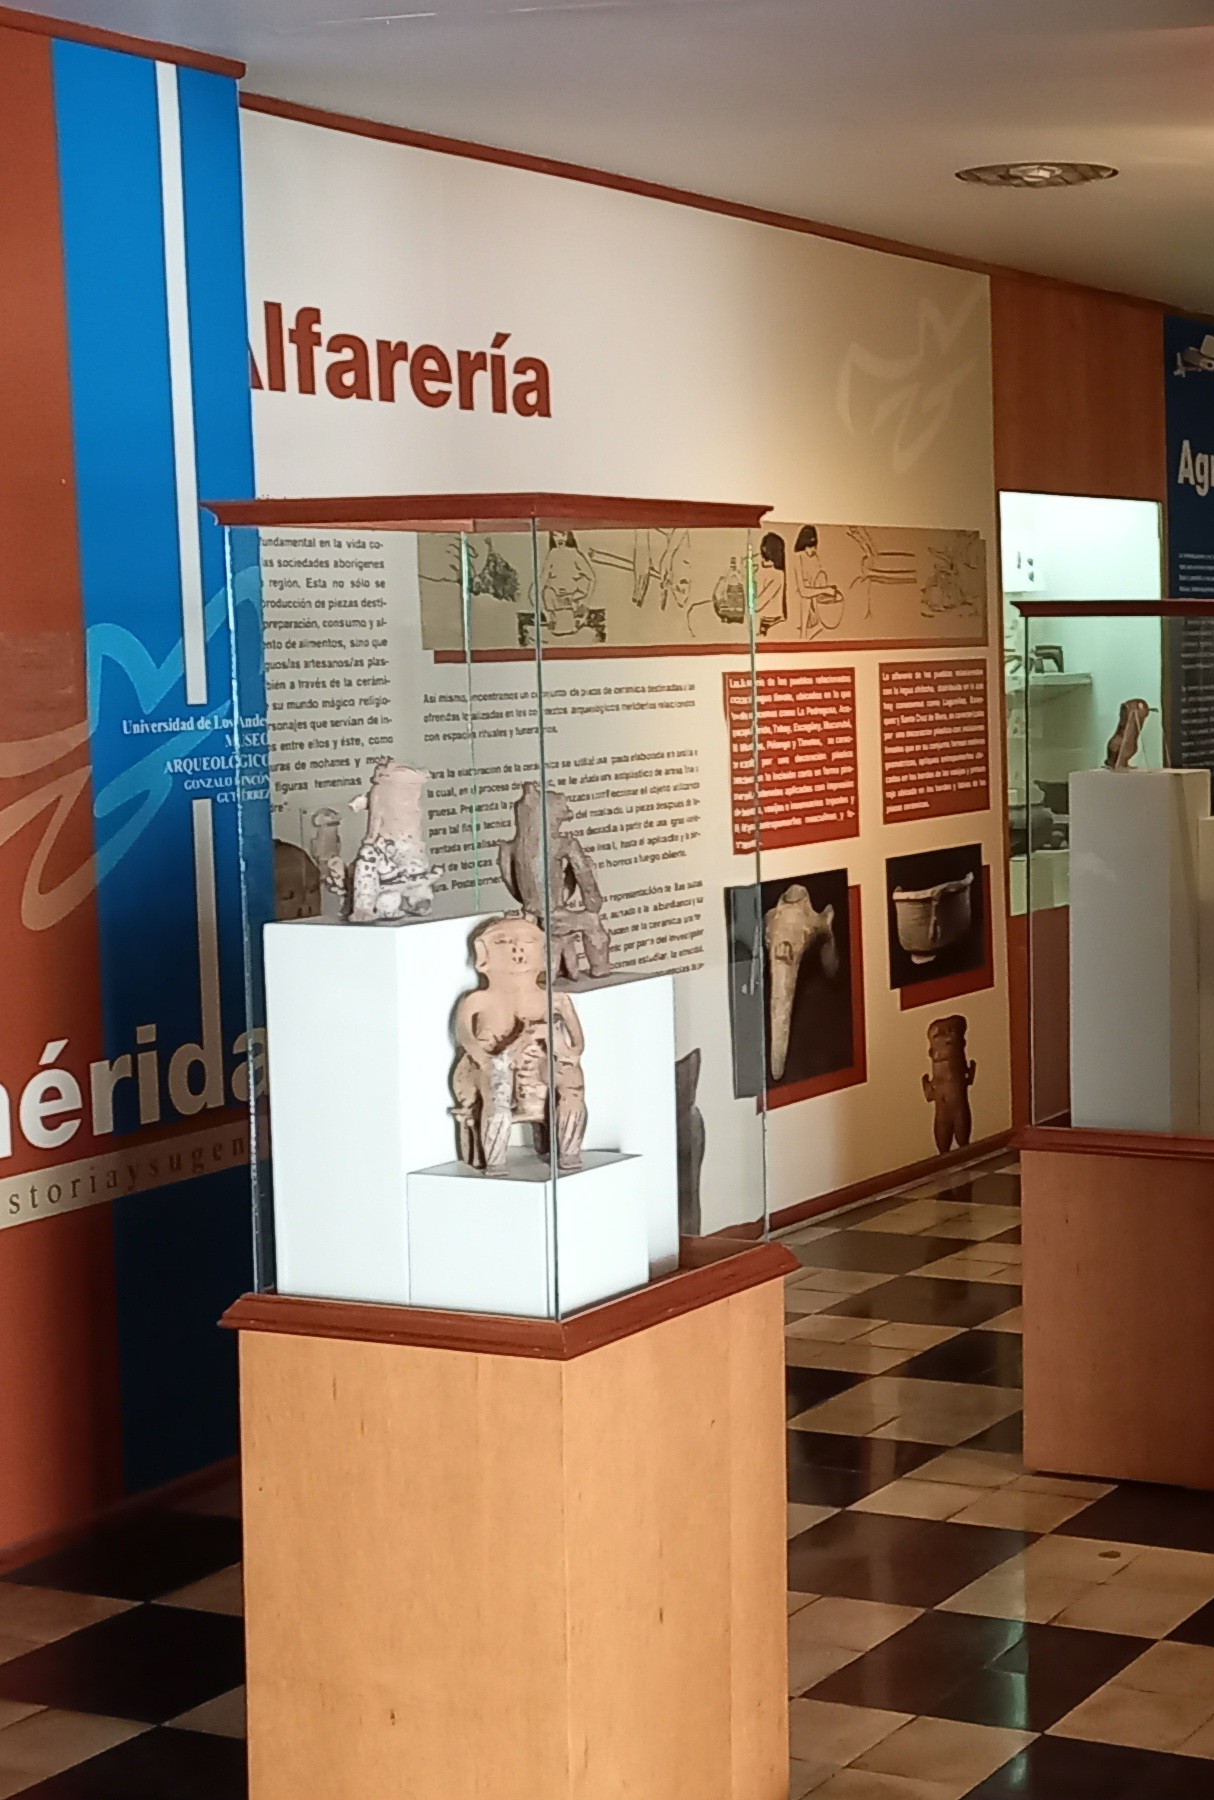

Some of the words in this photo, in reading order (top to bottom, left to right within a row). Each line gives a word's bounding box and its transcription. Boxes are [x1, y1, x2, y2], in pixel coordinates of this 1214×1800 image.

[249, 300, 552, 418] lfarería
[262, 558, 274, 568] as
[277, 558, 330, 568] sociedades
[122, 716, 194, 735] Universidad
[196, 716, 211, 731] de
[225, 732, 268, 748] MSEO
[184, 776, 232, 791] GONZALO
[235, 773, 270, 789] INCÓN
